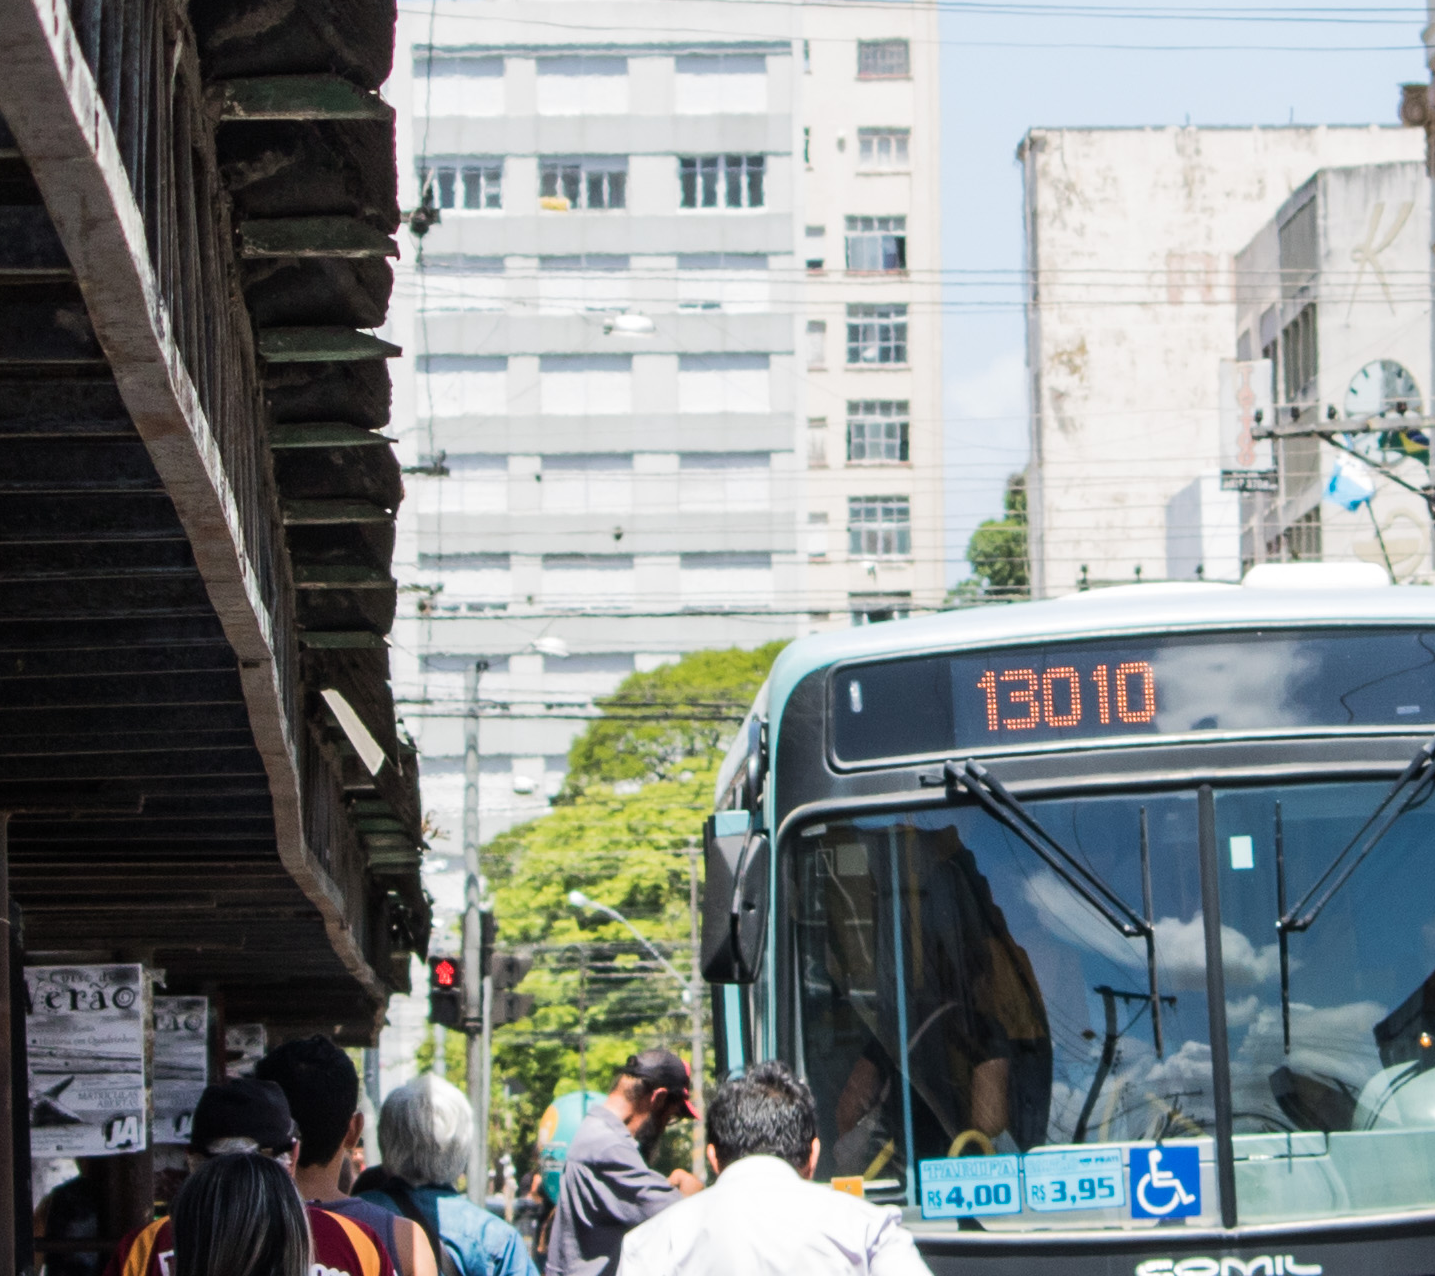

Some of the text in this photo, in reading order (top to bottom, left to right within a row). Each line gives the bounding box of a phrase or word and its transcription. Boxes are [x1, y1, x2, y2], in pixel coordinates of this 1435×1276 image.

[978, 661, 1156, 732] 13010
[924, 1160, 1013, 1179] TARIFA
[927, 1183, 1011, 1211] R$ 4,00
[1032, 1177, 1115, 1205] R$ 3,95
